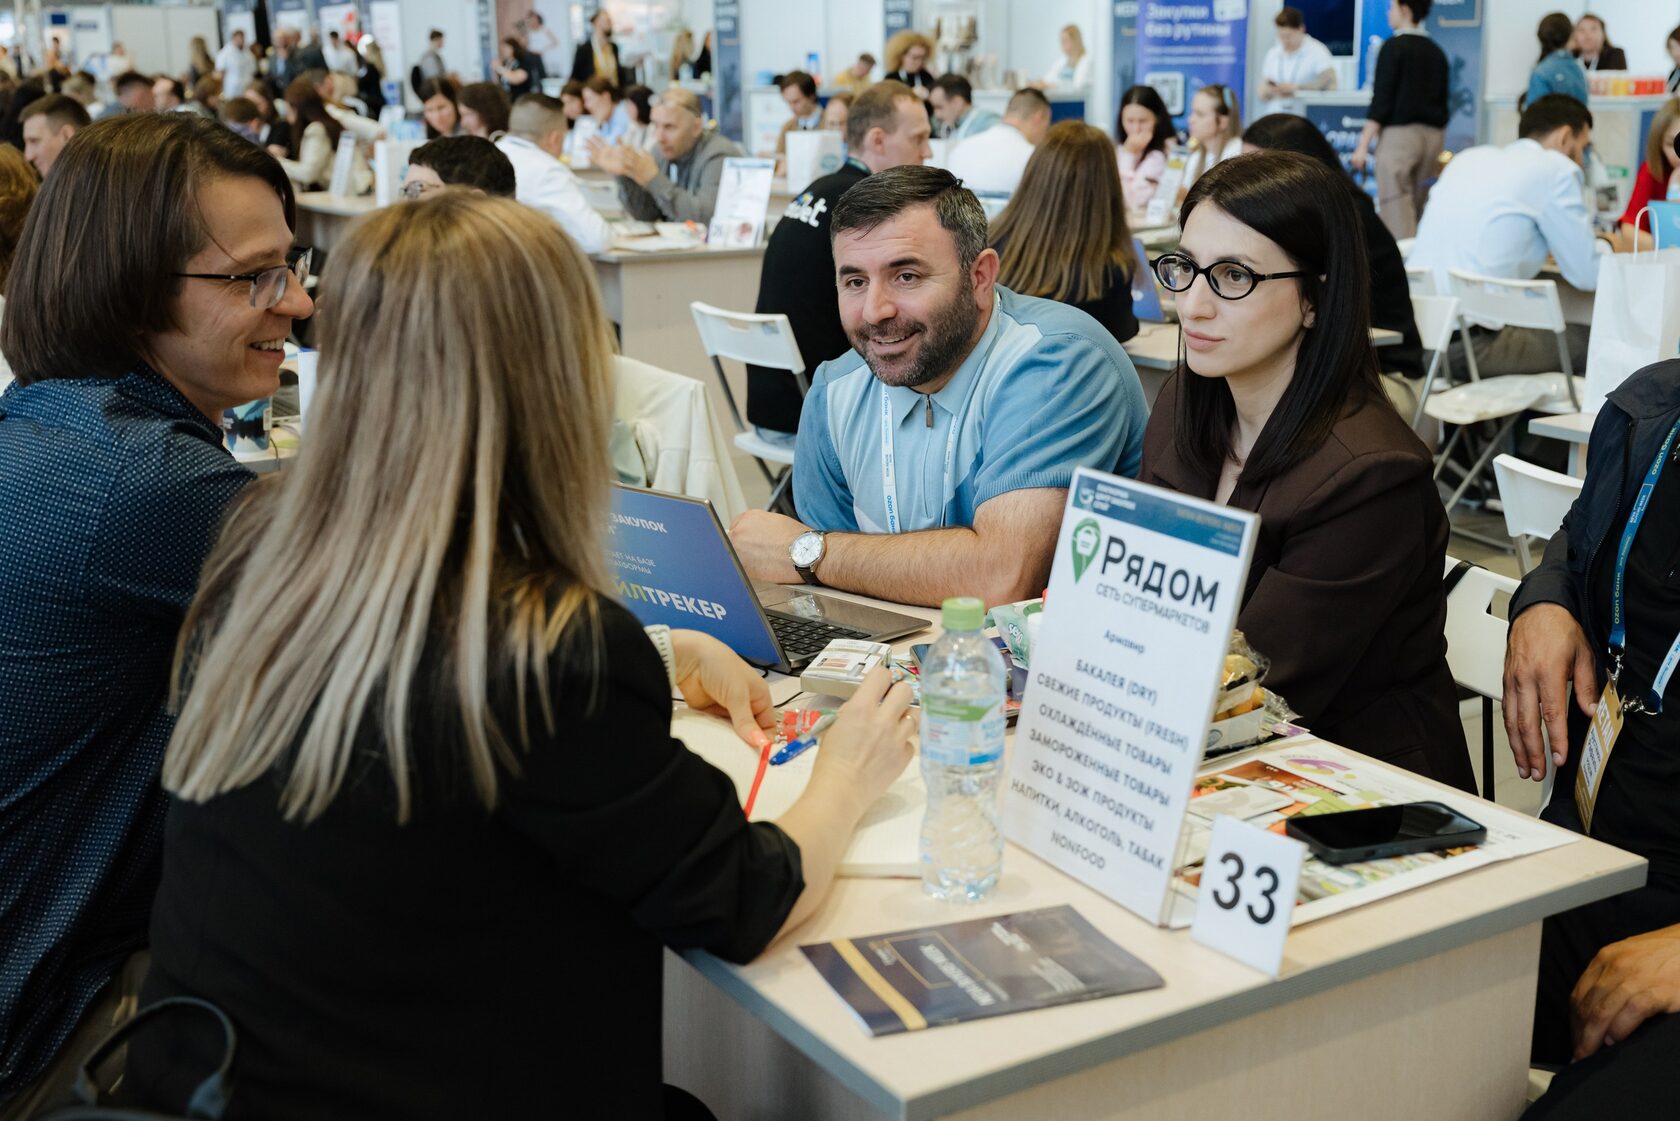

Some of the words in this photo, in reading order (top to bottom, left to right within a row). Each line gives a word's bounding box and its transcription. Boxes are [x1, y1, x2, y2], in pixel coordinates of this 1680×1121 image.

[1651, 451, 1665, 476] ozon
[610, 512, 668, 534] ЗАКУПОК
[886, 494, 894, 515] ozon
[1096, 583, 1121, 602] СЕТЬ
[1122, 592, 1211, 634] СУПЕРМАРКЕТОВ
[1037, 673, 1081, 702] СВЕЖИЕ
[1082, 691, 1144, 729] ПРОДУКТЫ
[1144, 719, 1189, 753] (FRESH)
[1076, 659, 1126, 689] БАКАЛЕЯ
[1126, 679, 1158, 706] (DRY)
[1029, 728, 1121, 783] ЗАМОРОЖЕННЫЕ
[1123, 773, 1171, 806] ТОВАРЫ
[1039, 703, 1122, 752] ОХЛАЖДЁННЫЕ
[1124, 742, 1173, 775] ТОВАРЫ
[1011, 778, 1061, 817] НАПИТКИ,
[1063, 807, 1124, 849] АЛКОГОЛЬ,
[1128, 840, 1165, 870] ТАБАК
[1031, 759, 1055, 780] ЭКО
[1055, 772, 1063, 785] &
[1065, 776, 1091, 799] ЗОЖ
[1092, 790, 1155, 832] ПРОДУКТЫ
[1051, 830, 1106, 870] NONFOOD
[1212, 852, 1280, 925] 33
